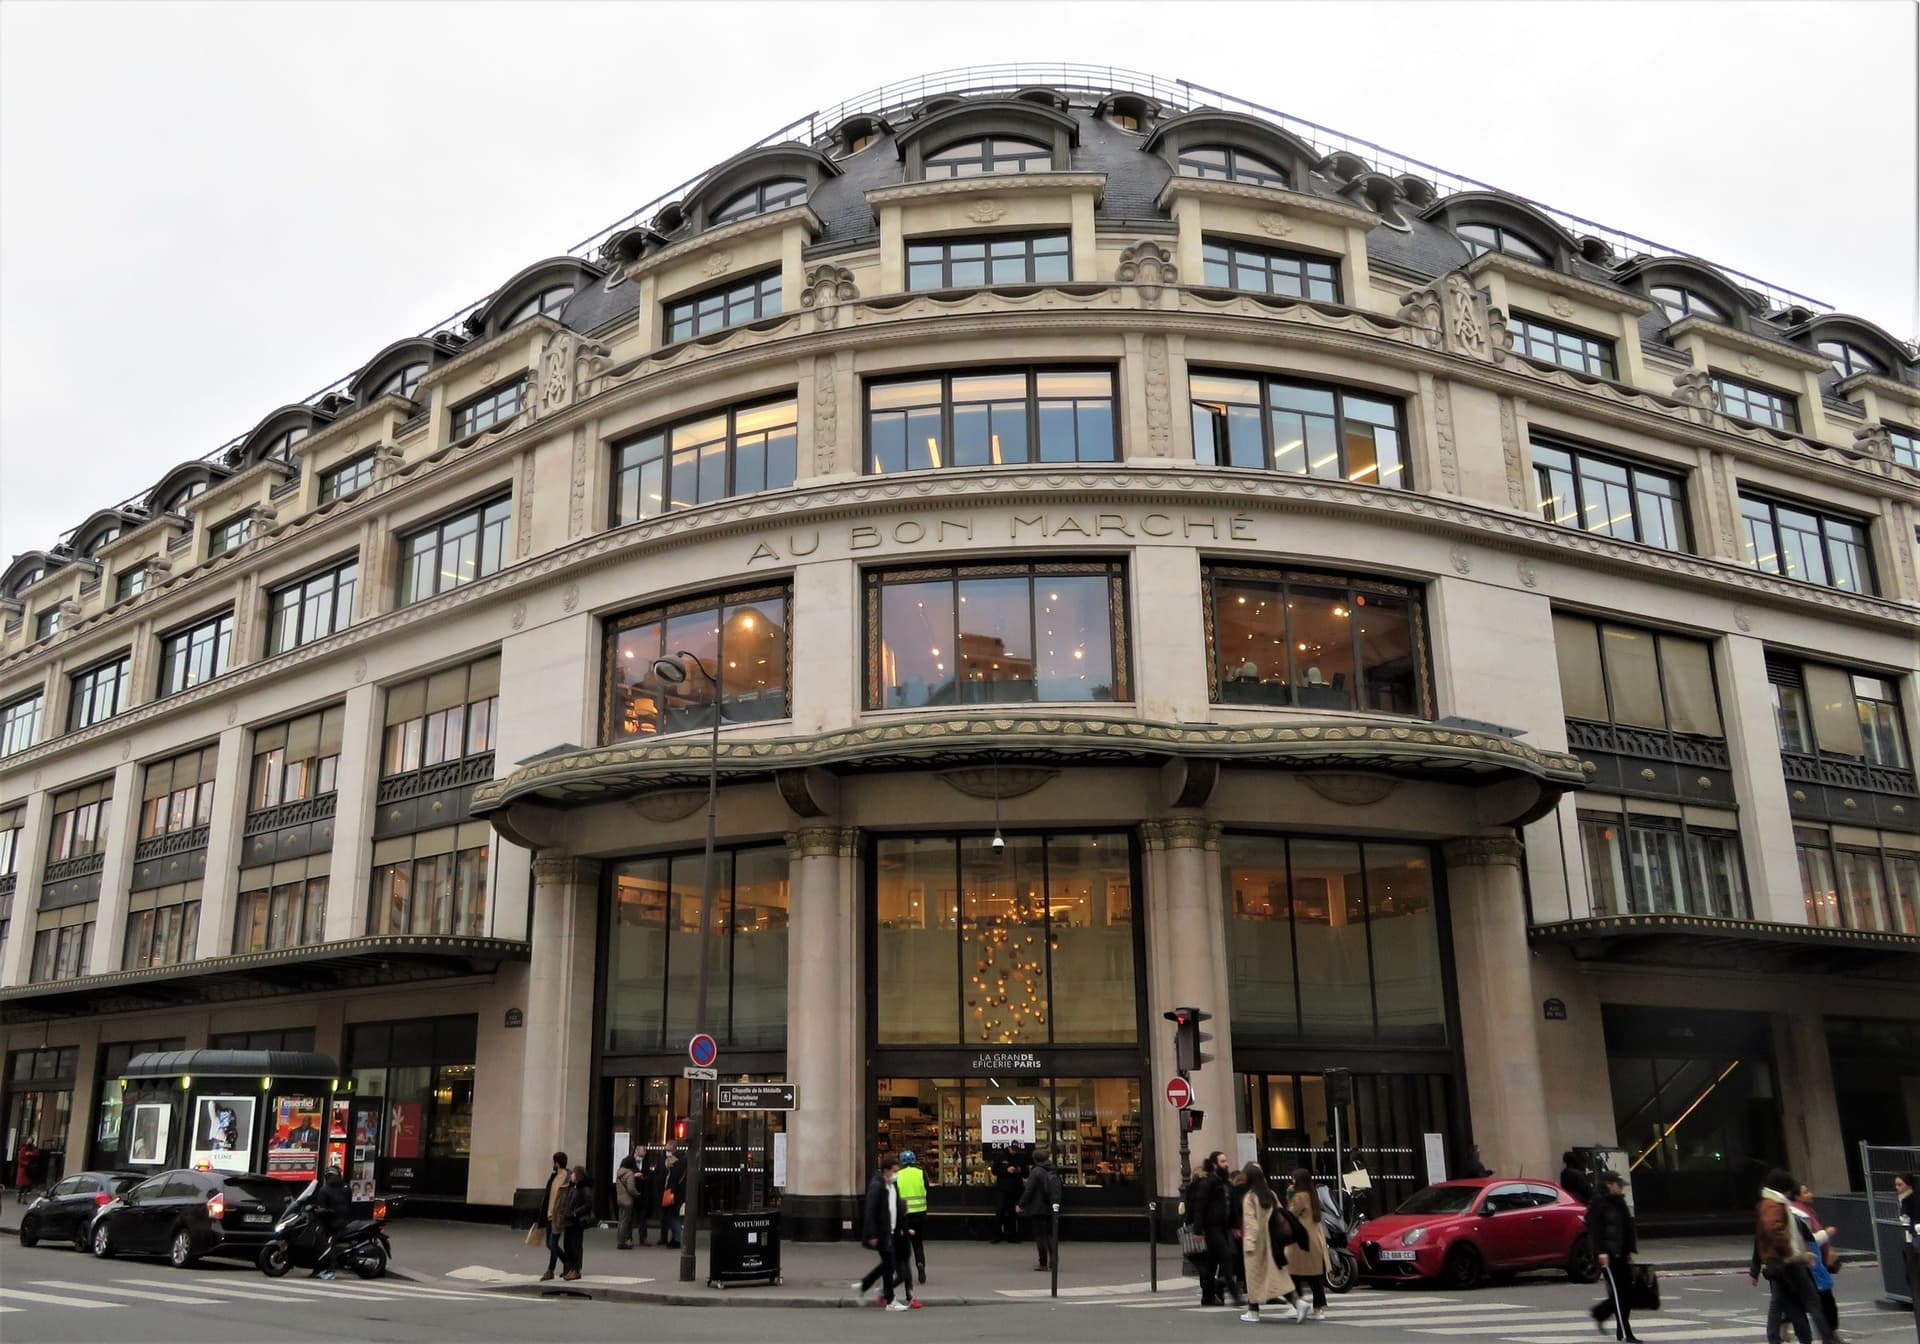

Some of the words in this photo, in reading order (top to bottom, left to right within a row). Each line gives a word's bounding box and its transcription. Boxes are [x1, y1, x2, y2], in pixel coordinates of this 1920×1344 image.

[747, 530, 820, 566] AU
[850, 517, 974, 551] BON
[1010, 513, 1257, 541] MARCHÉ
[980, 1053, 991, 1061] LA
[994, 1053, 1034, 1061] GRANDE
[972, 1060, 1012, 1068] EPICERIE
[1014, 1060, 1041, 1068] PARIS
[734, 1219, 770, 1228] VOITURIER
